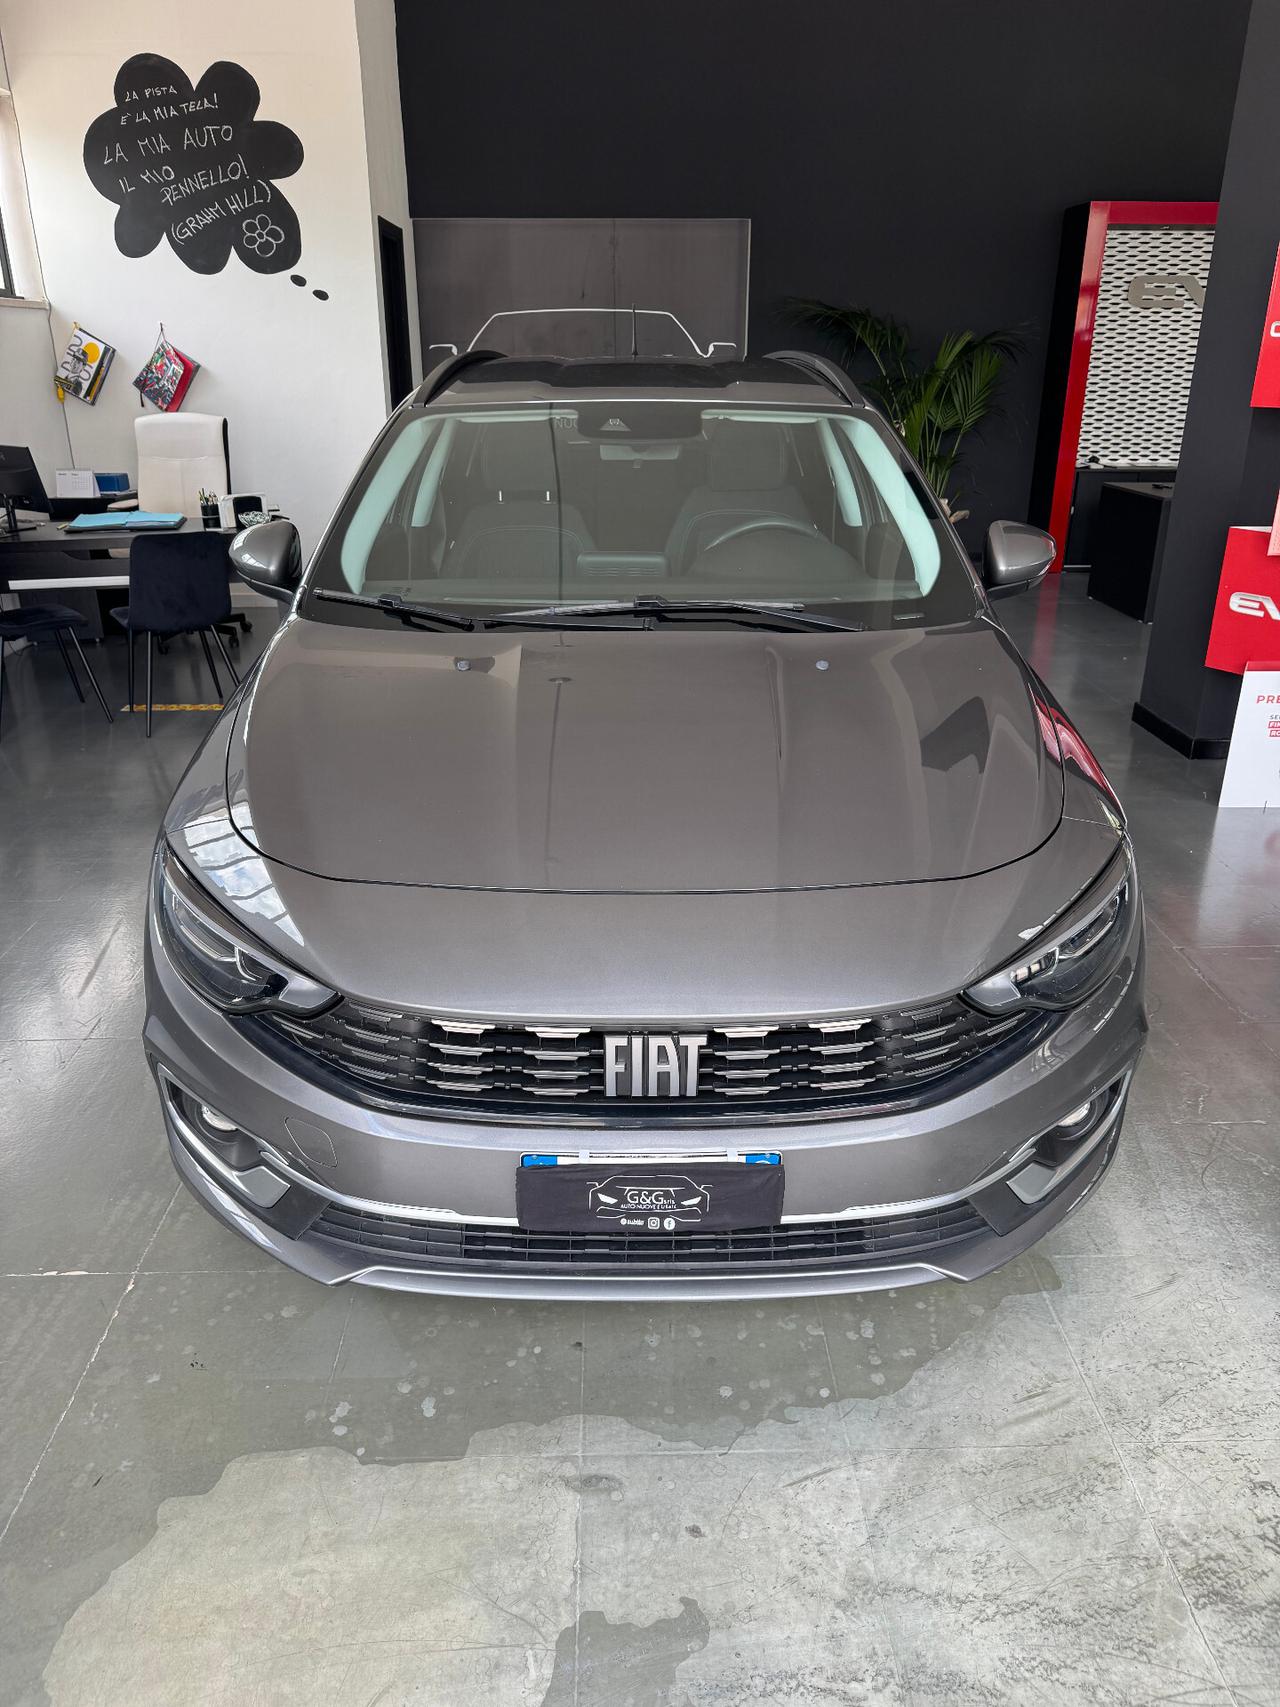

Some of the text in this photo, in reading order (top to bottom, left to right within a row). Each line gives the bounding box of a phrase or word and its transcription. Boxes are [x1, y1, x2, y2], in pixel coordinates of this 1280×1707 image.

[125, 85, 178, 101] LA PISTA
[135, 111, 151, 123] LA
[153, 105, 179, 121] MIA
[179, 93, 218, 112] TELA!
[103, 125, 233, 164] LA MIA AUTO
[119, 165, 175, 194] IL MIO
[160, 153, 250, 206] PENNELLO!
[225, 179, 271, 215] HILL)
[604, 1034, 708, 1097] FIAT
[626, 1190, 664, 1205] G&G
